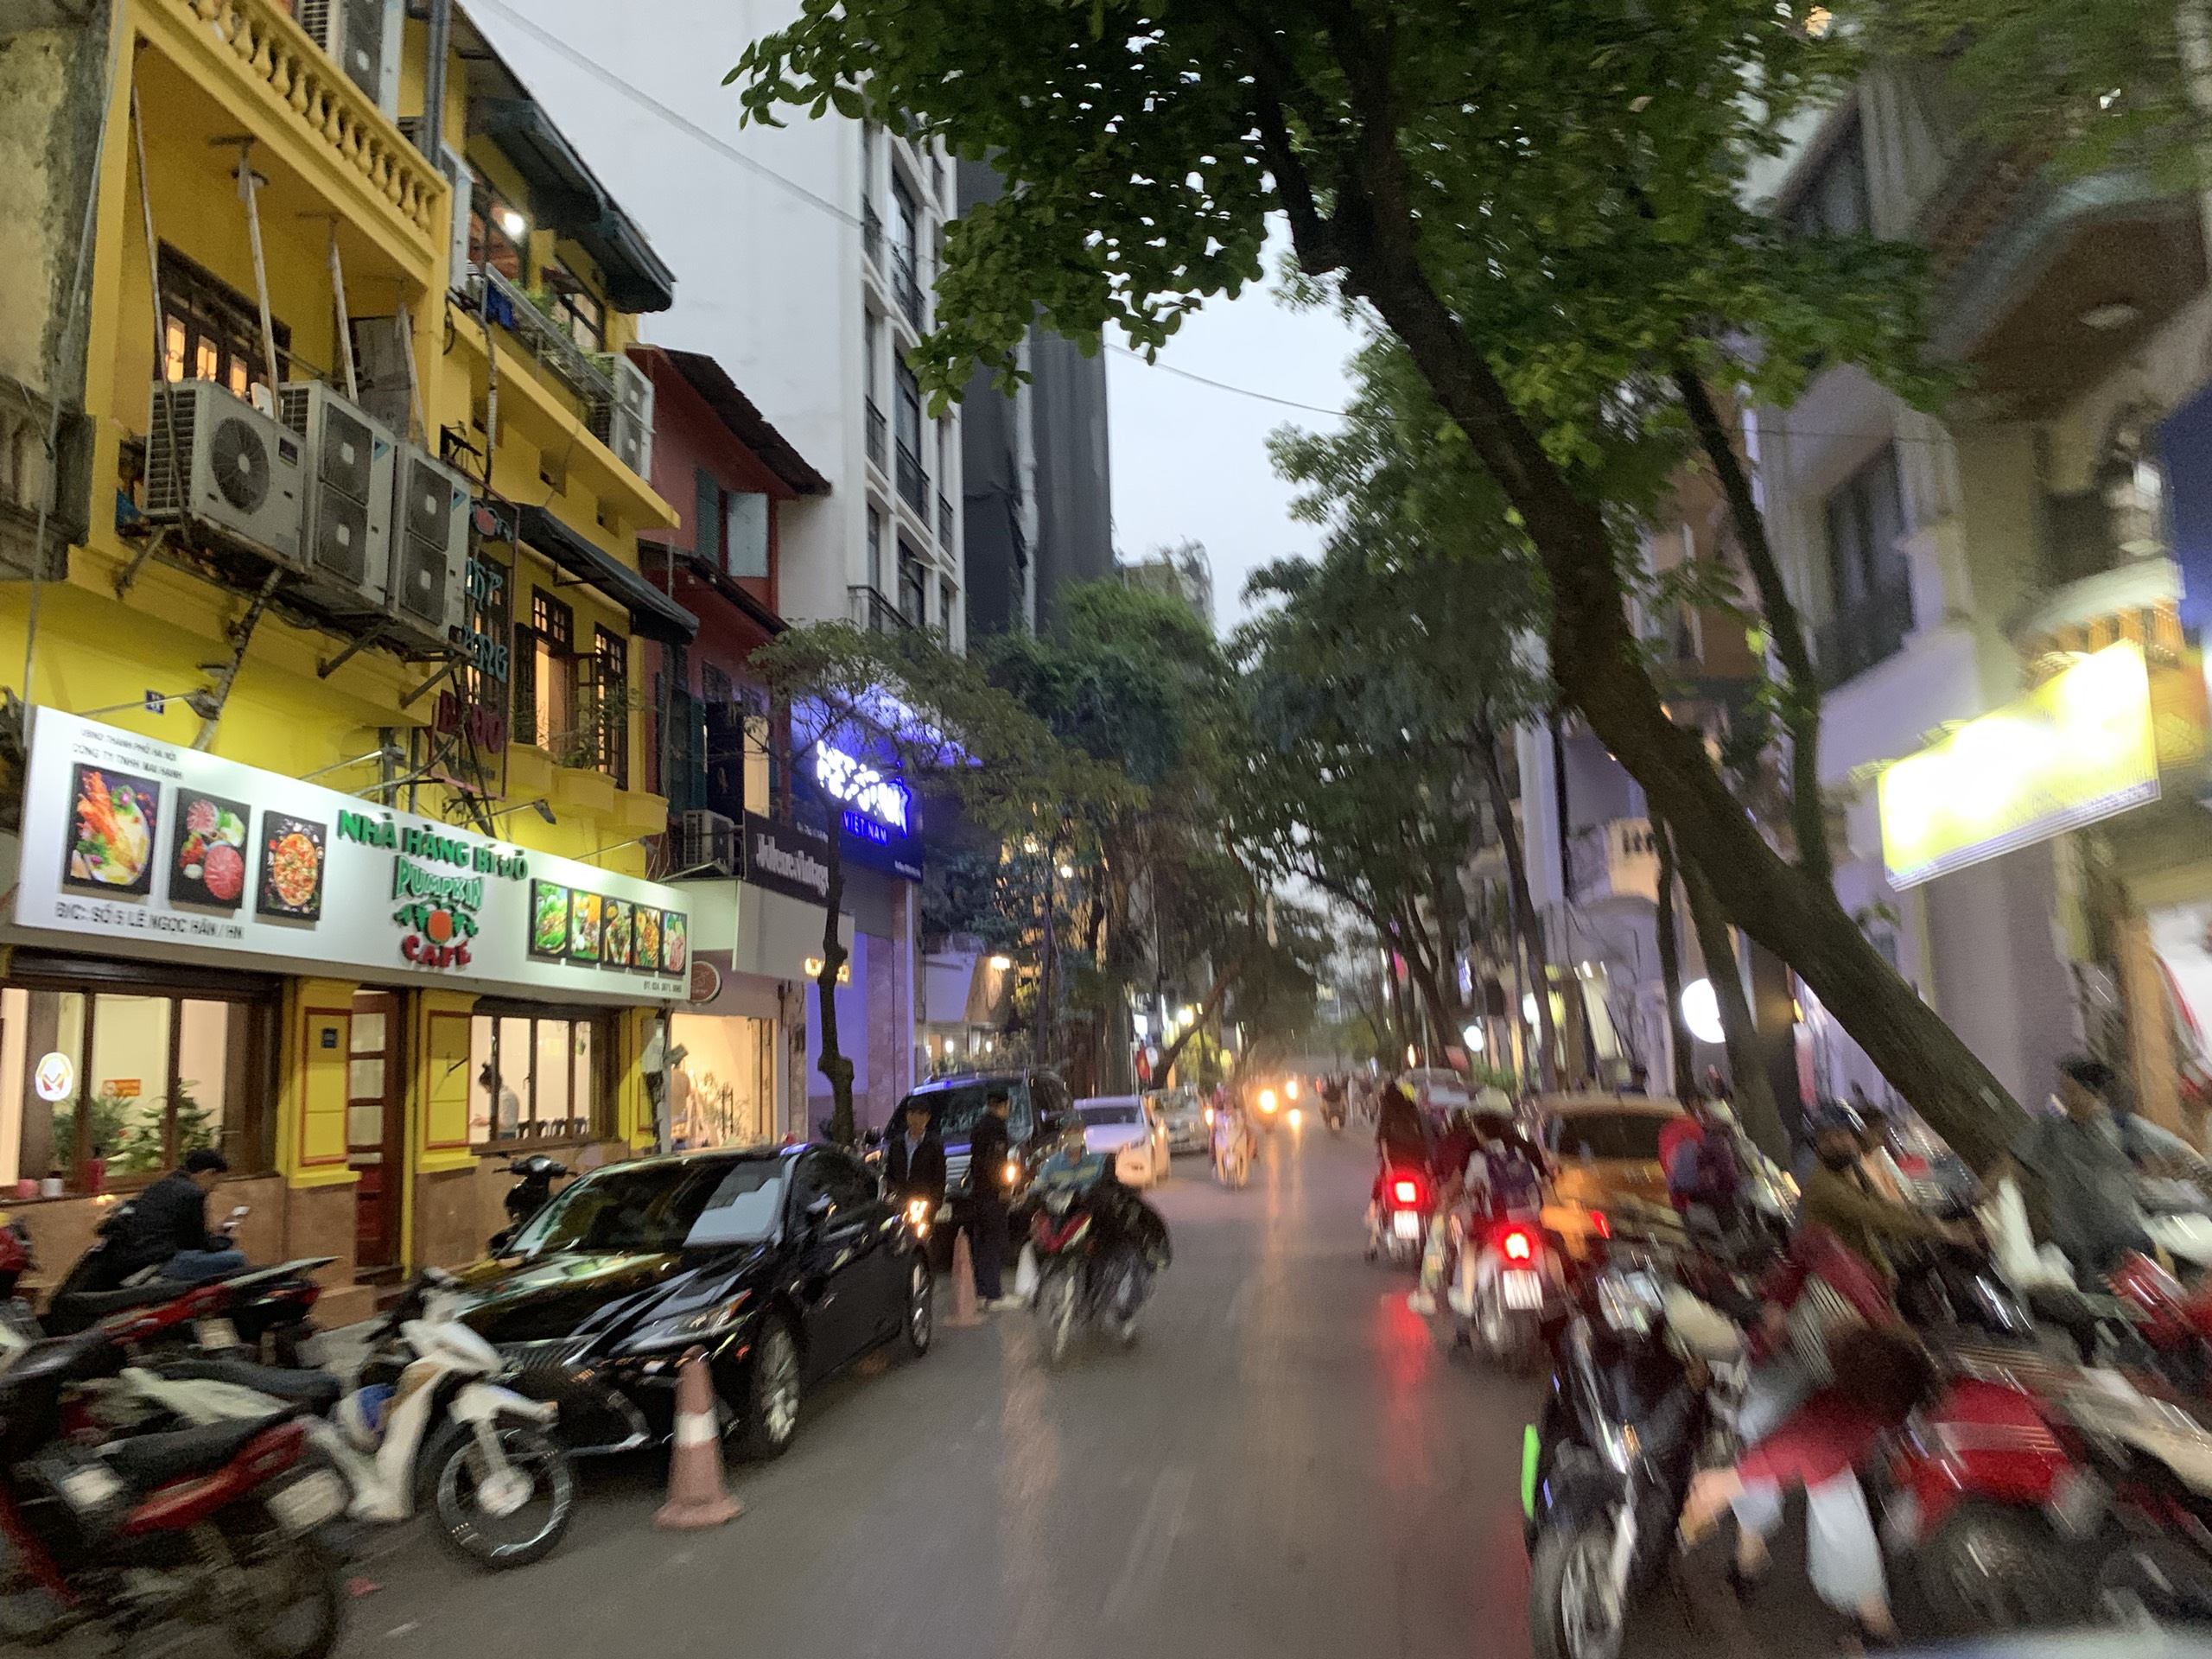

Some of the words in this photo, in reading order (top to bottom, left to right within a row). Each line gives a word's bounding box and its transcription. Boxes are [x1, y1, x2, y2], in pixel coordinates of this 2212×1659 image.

[338, 810, 397, 849] NHÀ
[402, 824, 470, 868] HÀNG
[842, 810, 865, 837] VIỆT
[868, 821, 888, 847] NAM
[392, 855, 484, 911] PUMPKIN
[128, 908, 145, 928] LÊ
